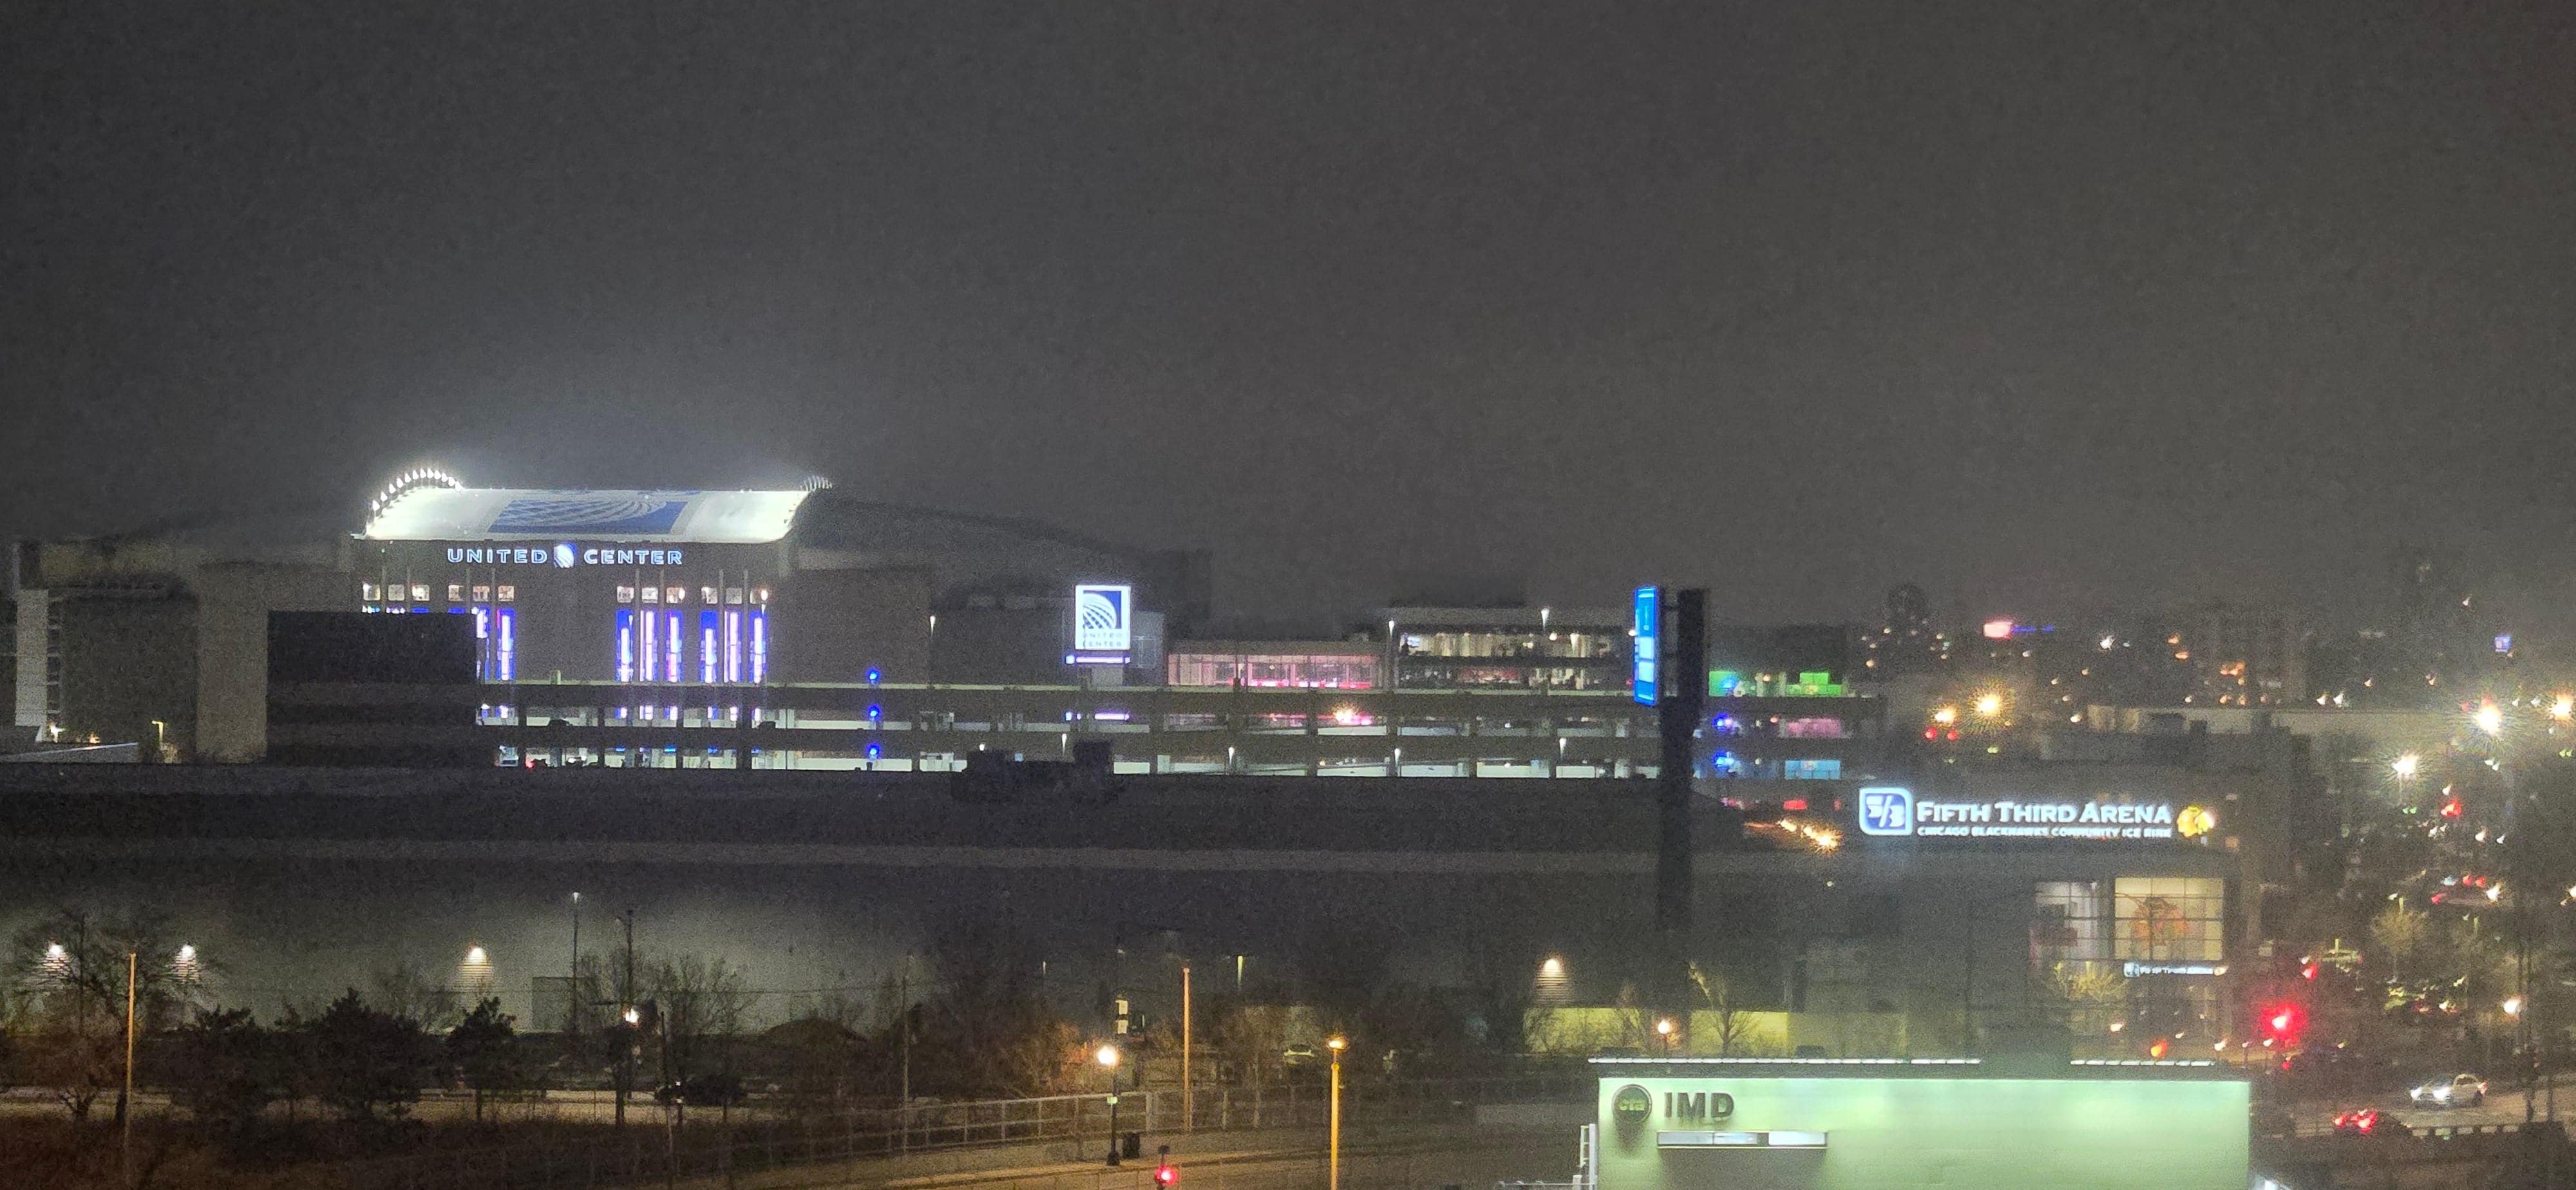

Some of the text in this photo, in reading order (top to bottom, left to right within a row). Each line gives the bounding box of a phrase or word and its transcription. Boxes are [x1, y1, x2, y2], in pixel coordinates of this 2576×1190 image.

[448, 548, 683, 565] UNITED CENTER
[1917, 802, 1990, 822] FIFTH
[1994, 802, 2078, 823] THIRD
[2079, 802, 2172, 824] ARENA
[1917, 826, 1969, 836] CHICAGO
[2122, 828, 2143, 837] ICE
[1664, 1092, 1735, 1119] IMD
